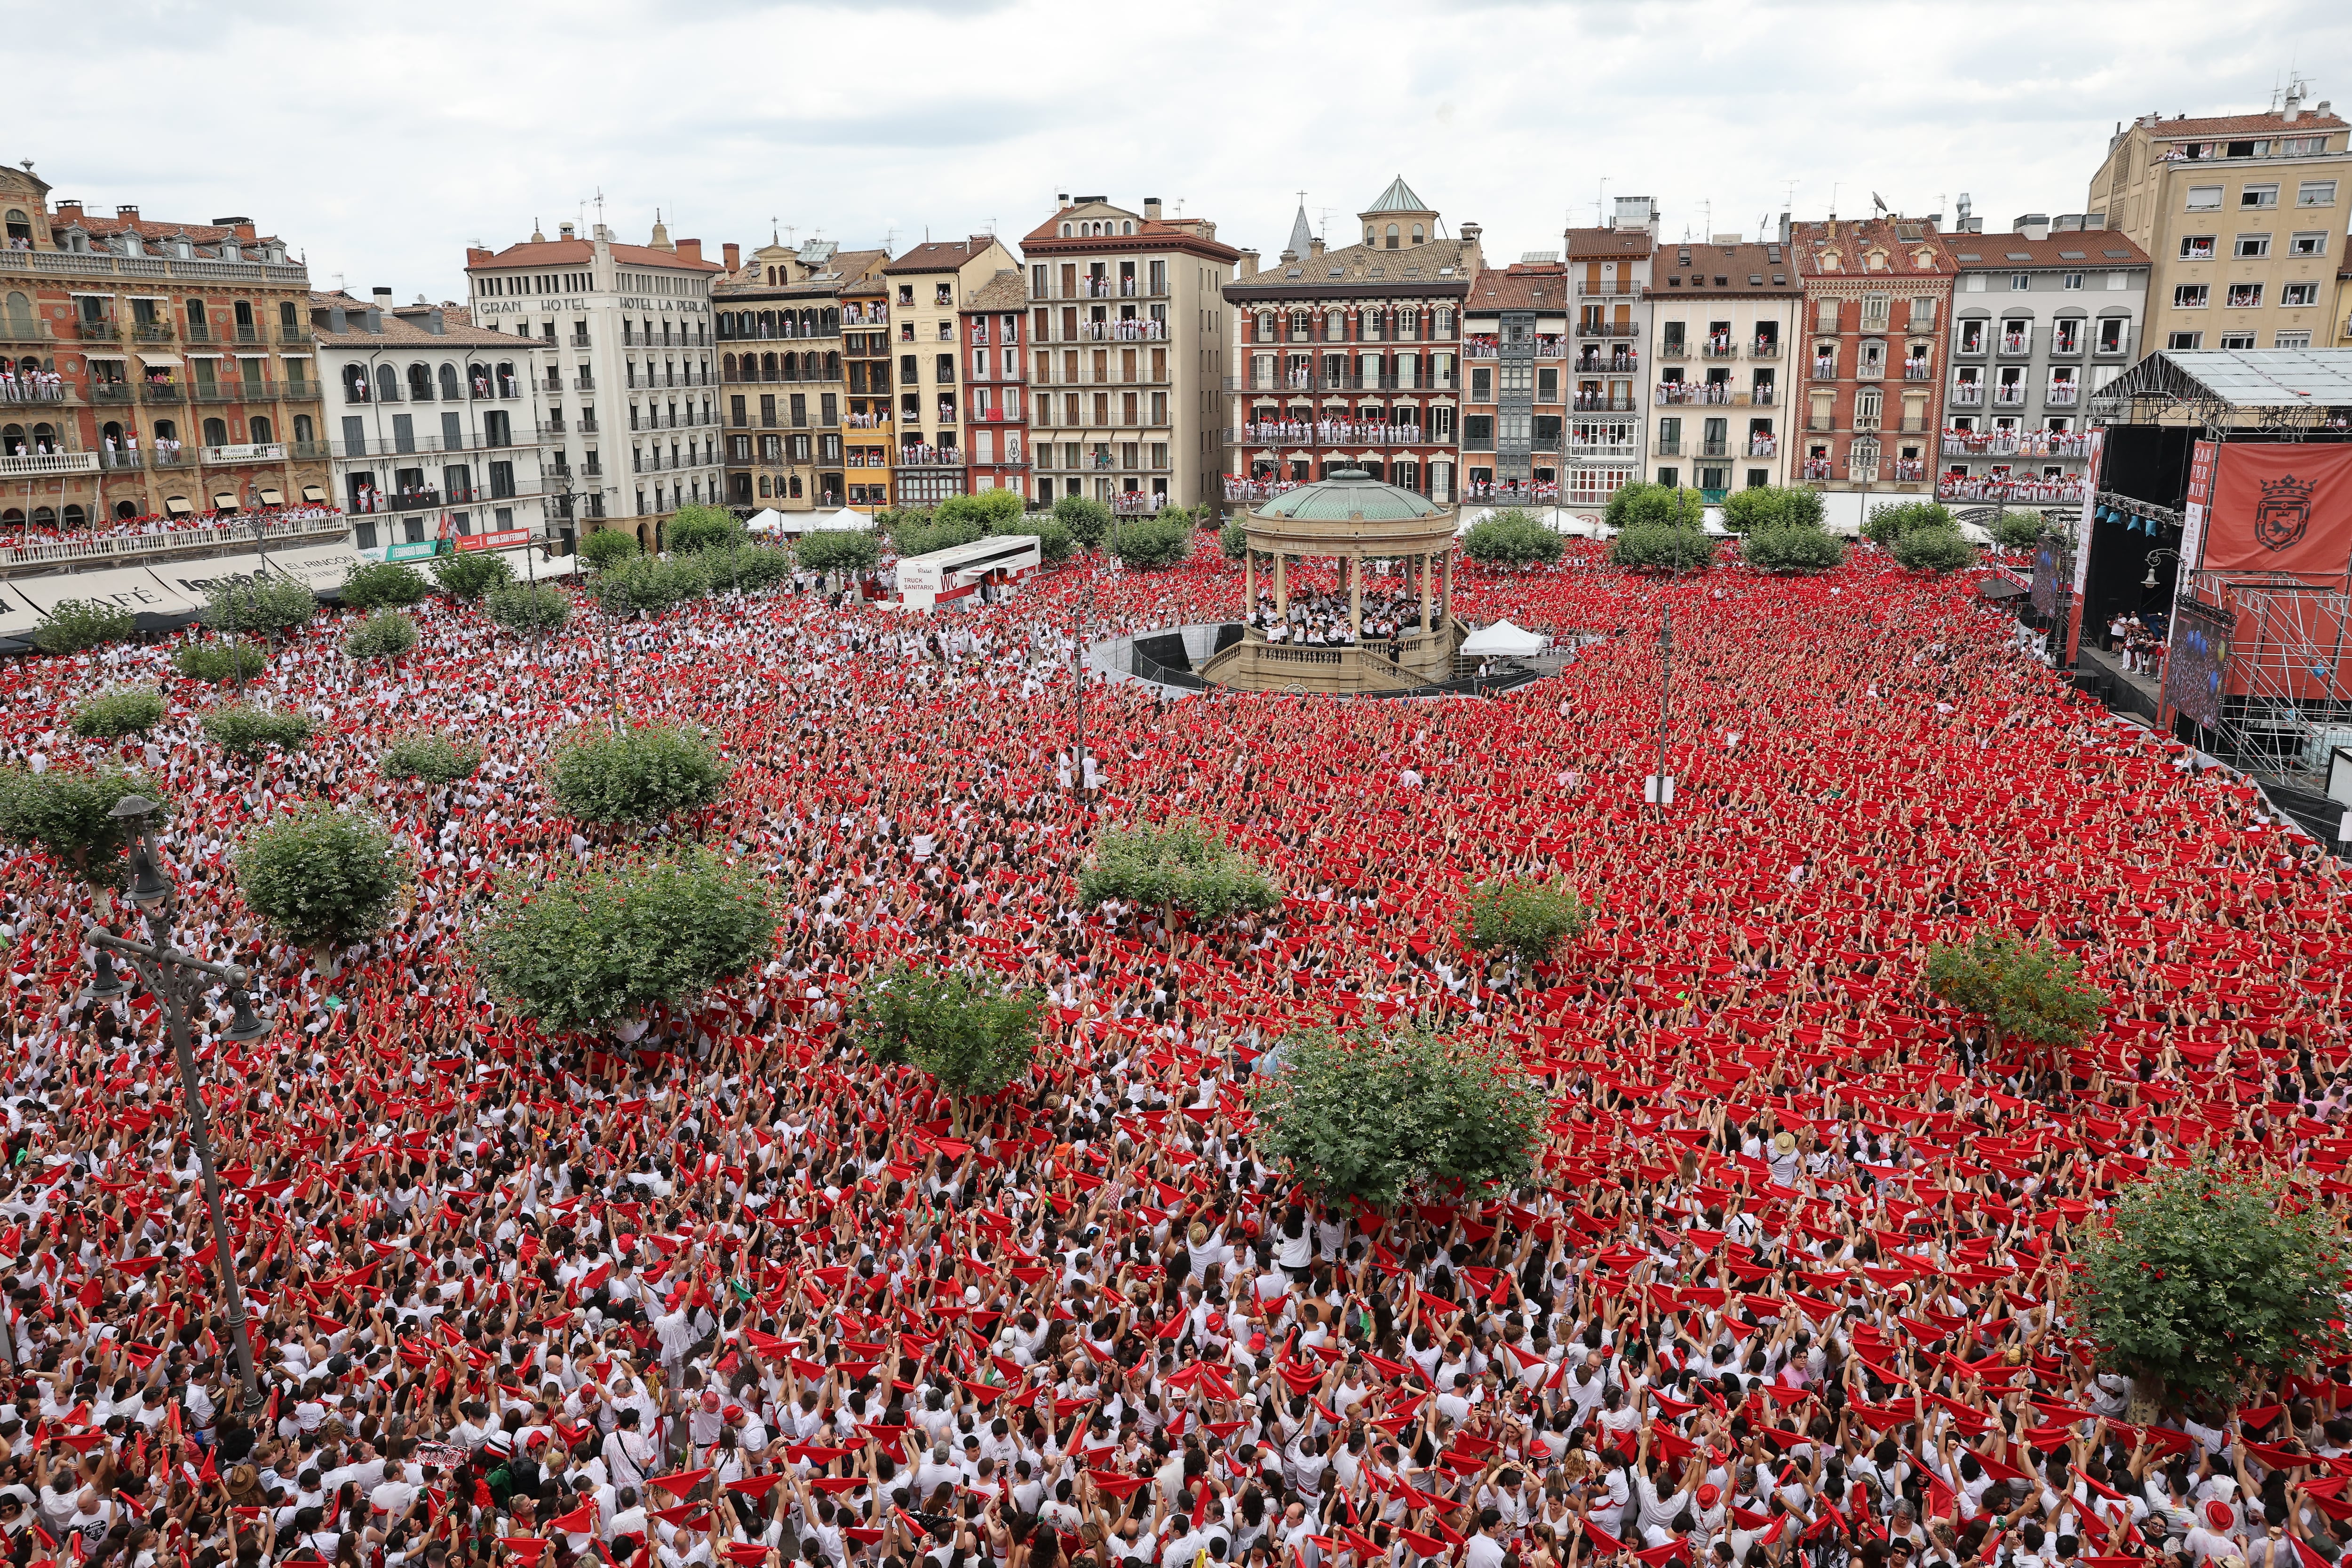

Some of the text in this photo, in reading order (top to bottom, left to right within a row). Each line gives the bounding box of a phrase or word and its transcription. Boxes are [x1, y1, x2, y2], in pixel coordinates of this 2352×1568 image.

[480, 298, 591, 314] GRAN HOTEL
[620, 297, 708, 312] HOTEL LA PERLA
[2193, 447, 2211, 463] SAN
[2188, 479, 2206, 498] MÍN
[486, 534, 500, 545] GORA
[500, 533, 510, 543] SAN
[395, 545, 415, 558] EGINGO
[415, 544, 433, 556] DUGU.
[303, 556, 357, 568] RINCÓN
[940, 572, 957, 592] WC
